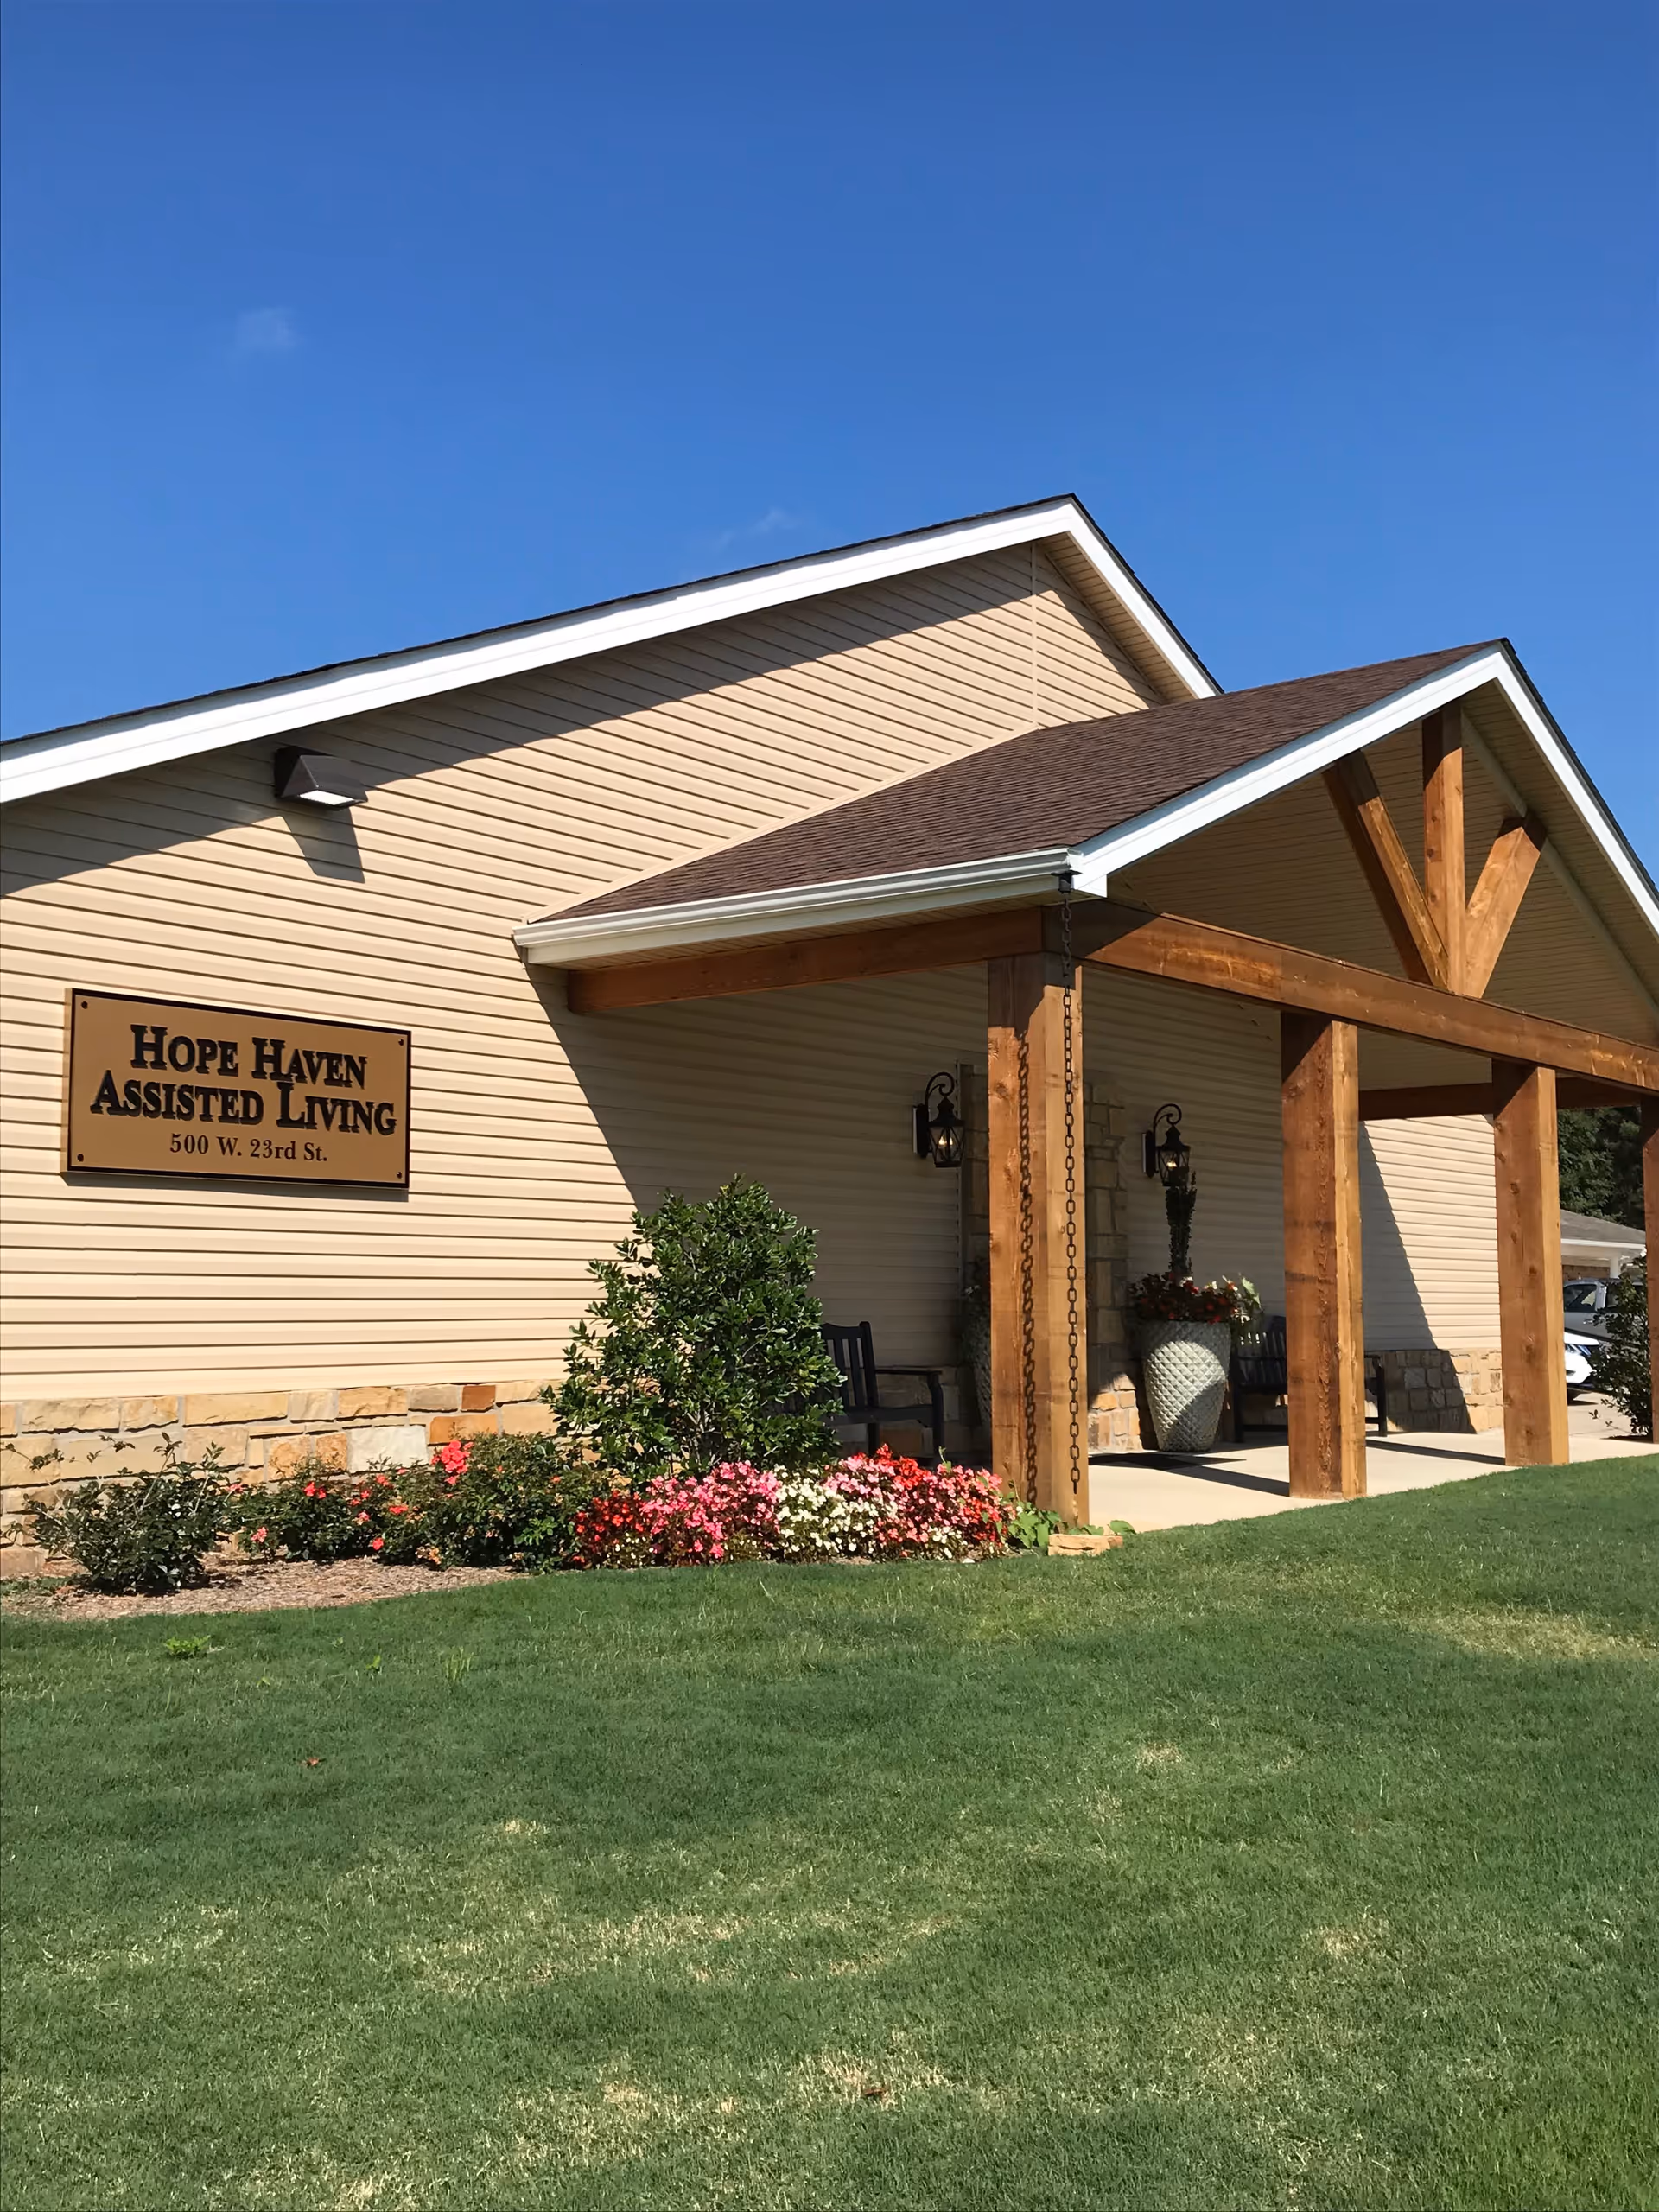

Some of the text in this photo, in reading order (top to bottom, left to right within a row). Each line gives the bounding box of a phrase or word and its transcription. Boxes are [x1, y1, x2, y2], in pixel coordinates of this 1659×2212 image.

[130, 1024, 368, 1090] HOPE HAVEN
[90, 1069, 397, 1136] ASSISTED LIVING
[169, 1133, 328, 1162] 500 W. 23rd St.
